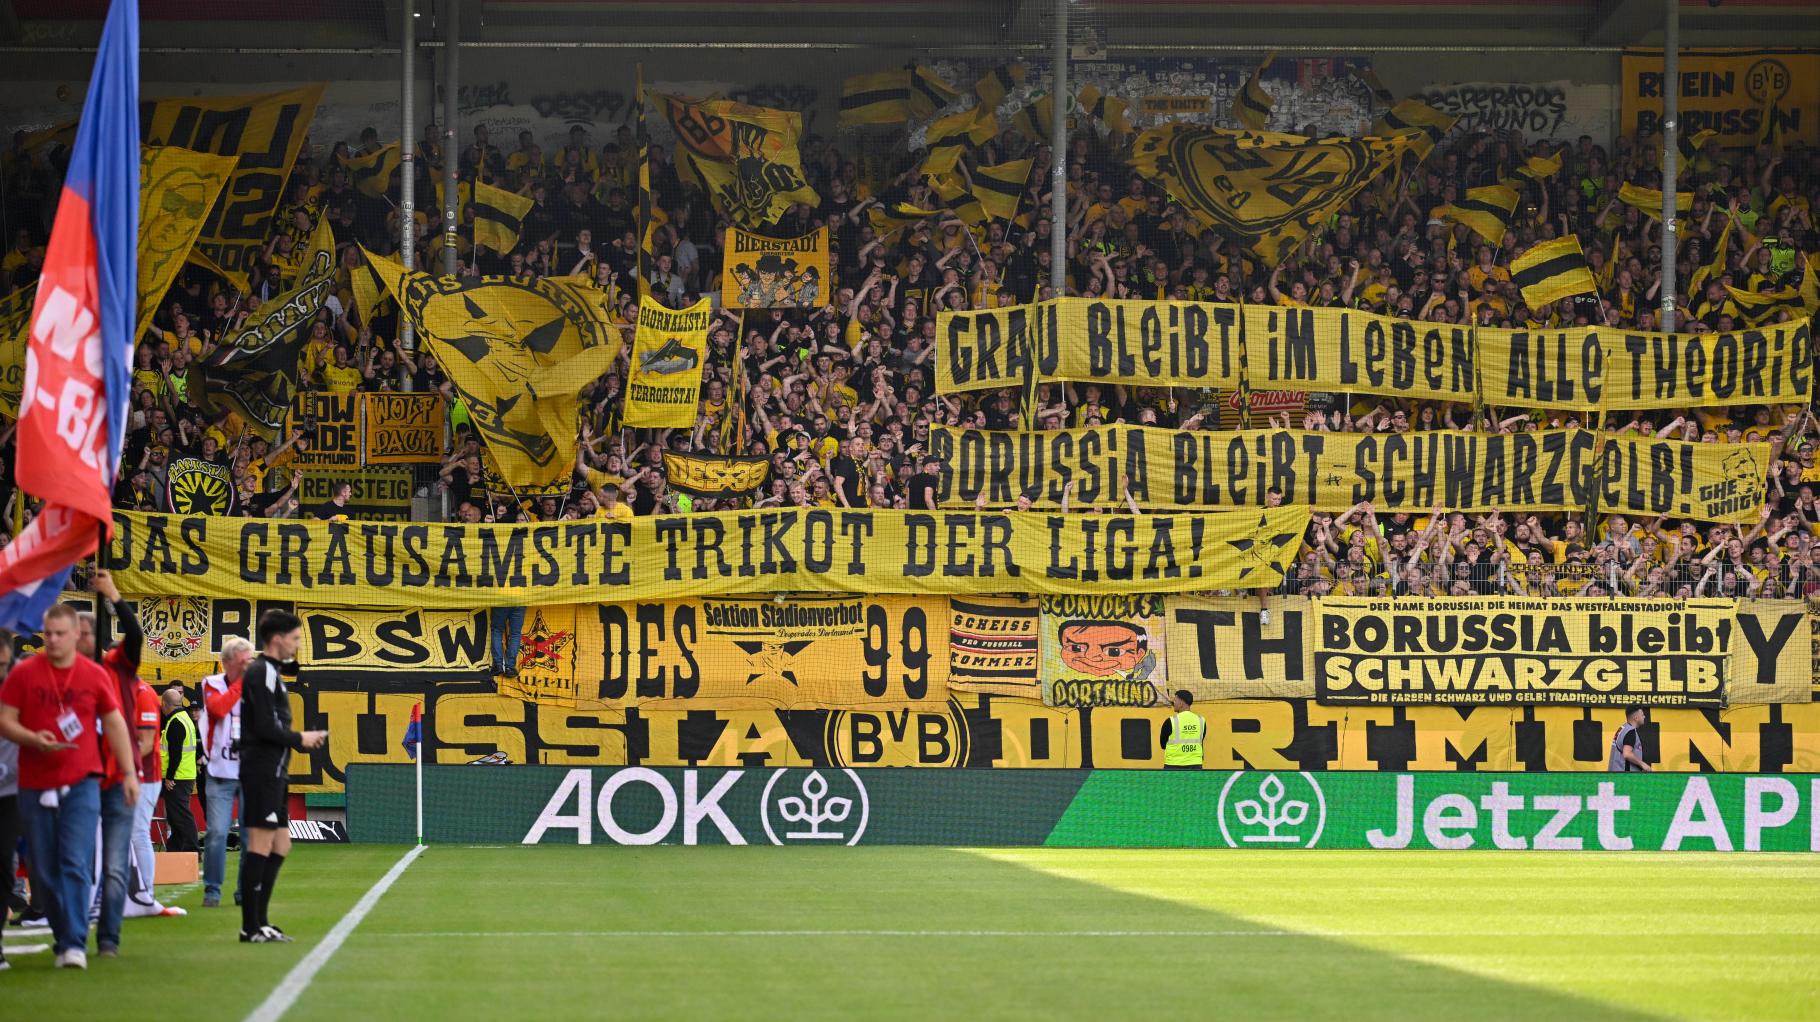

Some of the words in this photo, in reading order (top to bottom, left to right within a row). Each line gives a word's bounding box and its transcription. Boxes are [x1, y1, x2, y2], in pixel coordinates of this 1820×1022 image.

[1639, 71, 1734, 97] REIN
[735, 229, 820, 253] BIERSTADT
[948, 303, 1059, 386] GRAU
[631, 384, 697, 405] TERRORISTA!
[292, 425, 355, 451] IDE
[303, 478, 409, 501] RENSTEIG
[103, 512, 210, 575] DAS
[240, 522, 631, 589] GRAUSAMSTE
[655, 510, 874, 580] TRIKOT
[904, 515, 1020, 578] DER
[1046, 516, 1202, 583] LIGA!
[156, 601, 196, 631] BVB
[703, 602, 760, 628] Sektion
[761, 601, 864, 628] Stadionverbot
[1369, 602, 1390, 611] DER
[1394, 602, 1424, 611] NAME
[1427, 601, 1484, 611] BORUSSIA!
[1487, 601, 1505, 610] DIE
[1508, 601, 1547, 611] HEIMAT
[1551, 602, 1573, 611] DAS
[1575, 602, 1686, 612] WESTFALENSTADION!
[953, 614, 1031, 631] SCHEISS
[1322, 613, 1573, 653] BORUSSIA
[1588, 612, 1732, 654] bleibt
[307, 609, 488, 665] BSW
[599, 603, 700, 699] DES
[962, 638, 979, 646] PRO
[1176, 608, 1304, 682] TH
[862, 604, 933, 699] 99
[951, 651, 1035, 667] KOMMERZ
[1324, 655, 1720, 693] SCHWARZGELB
[1052, 678, 1158, 708] DORTMUND
[1370, 692, 1387, 702] DIE
[1391, 692, 1432, 702] FARBEN
[1434, 692, 1486, 702] SCHWARZ
[1489, 692, 1512, 702] UND
[1516, 692, 1547, 702] GELB!
[1549, 692, 1607, 704] TRADITION
[1609, 694, 1687, 705] VERPFLICHTET!
[860, 708, 961, 764] BVB
[988, 700, 1820, 772] DORTMUN
[521, 766, 749, 846] AOK
[1366, 774, 1634, 850] Jetzt
[1660, 776, 1820, 851] AP
[288, 820, 325, 840] UMA
